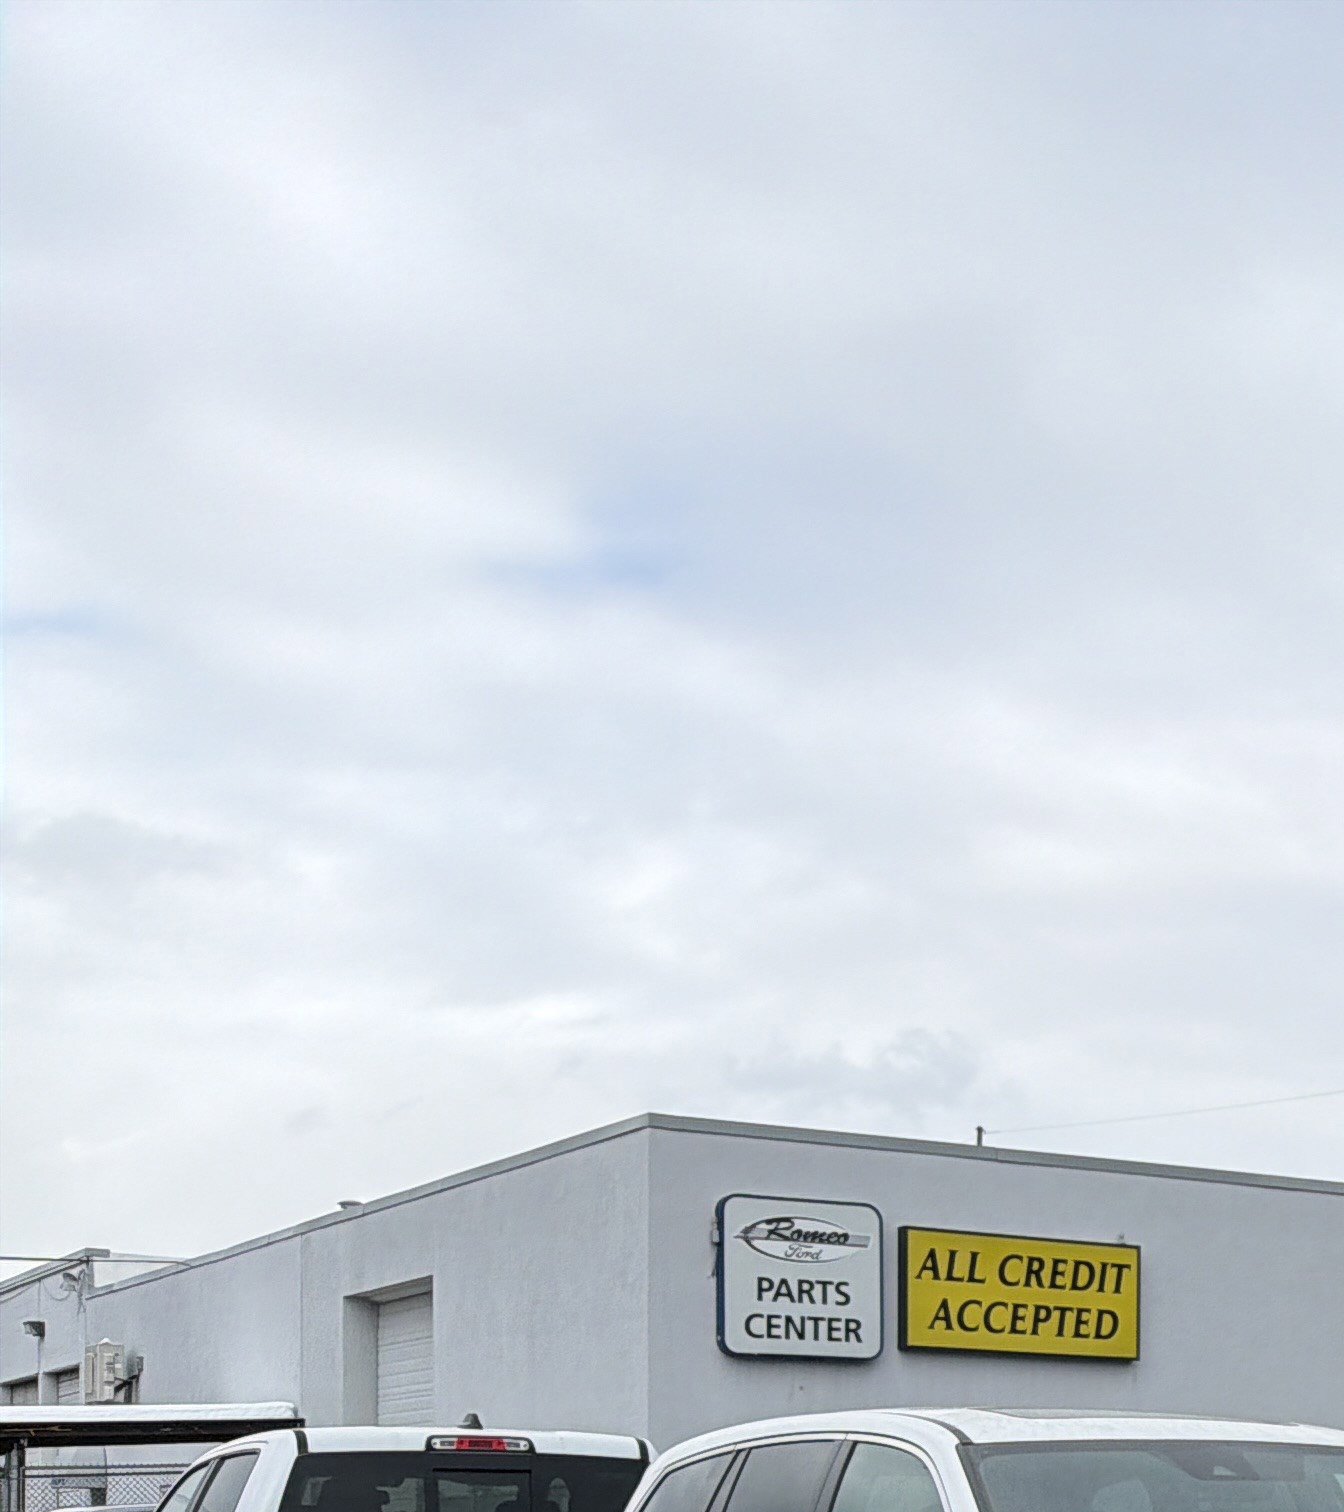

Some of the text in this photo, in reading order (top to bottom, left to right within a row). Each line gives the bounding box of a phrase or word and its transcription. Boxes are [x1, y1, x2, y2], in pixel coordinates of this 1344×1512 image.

[764, 1216, 850, 1245] Romeo
[784, 1243, 824, 1261] Ford
[914, 1247, 1132, 1295] ALL CREDIT
[756, 1275, 851, 1307] PARTS
[743, 1312, 863, 1344] CENTER
[928, 1297, 1120, 1341] ACCEPTED
